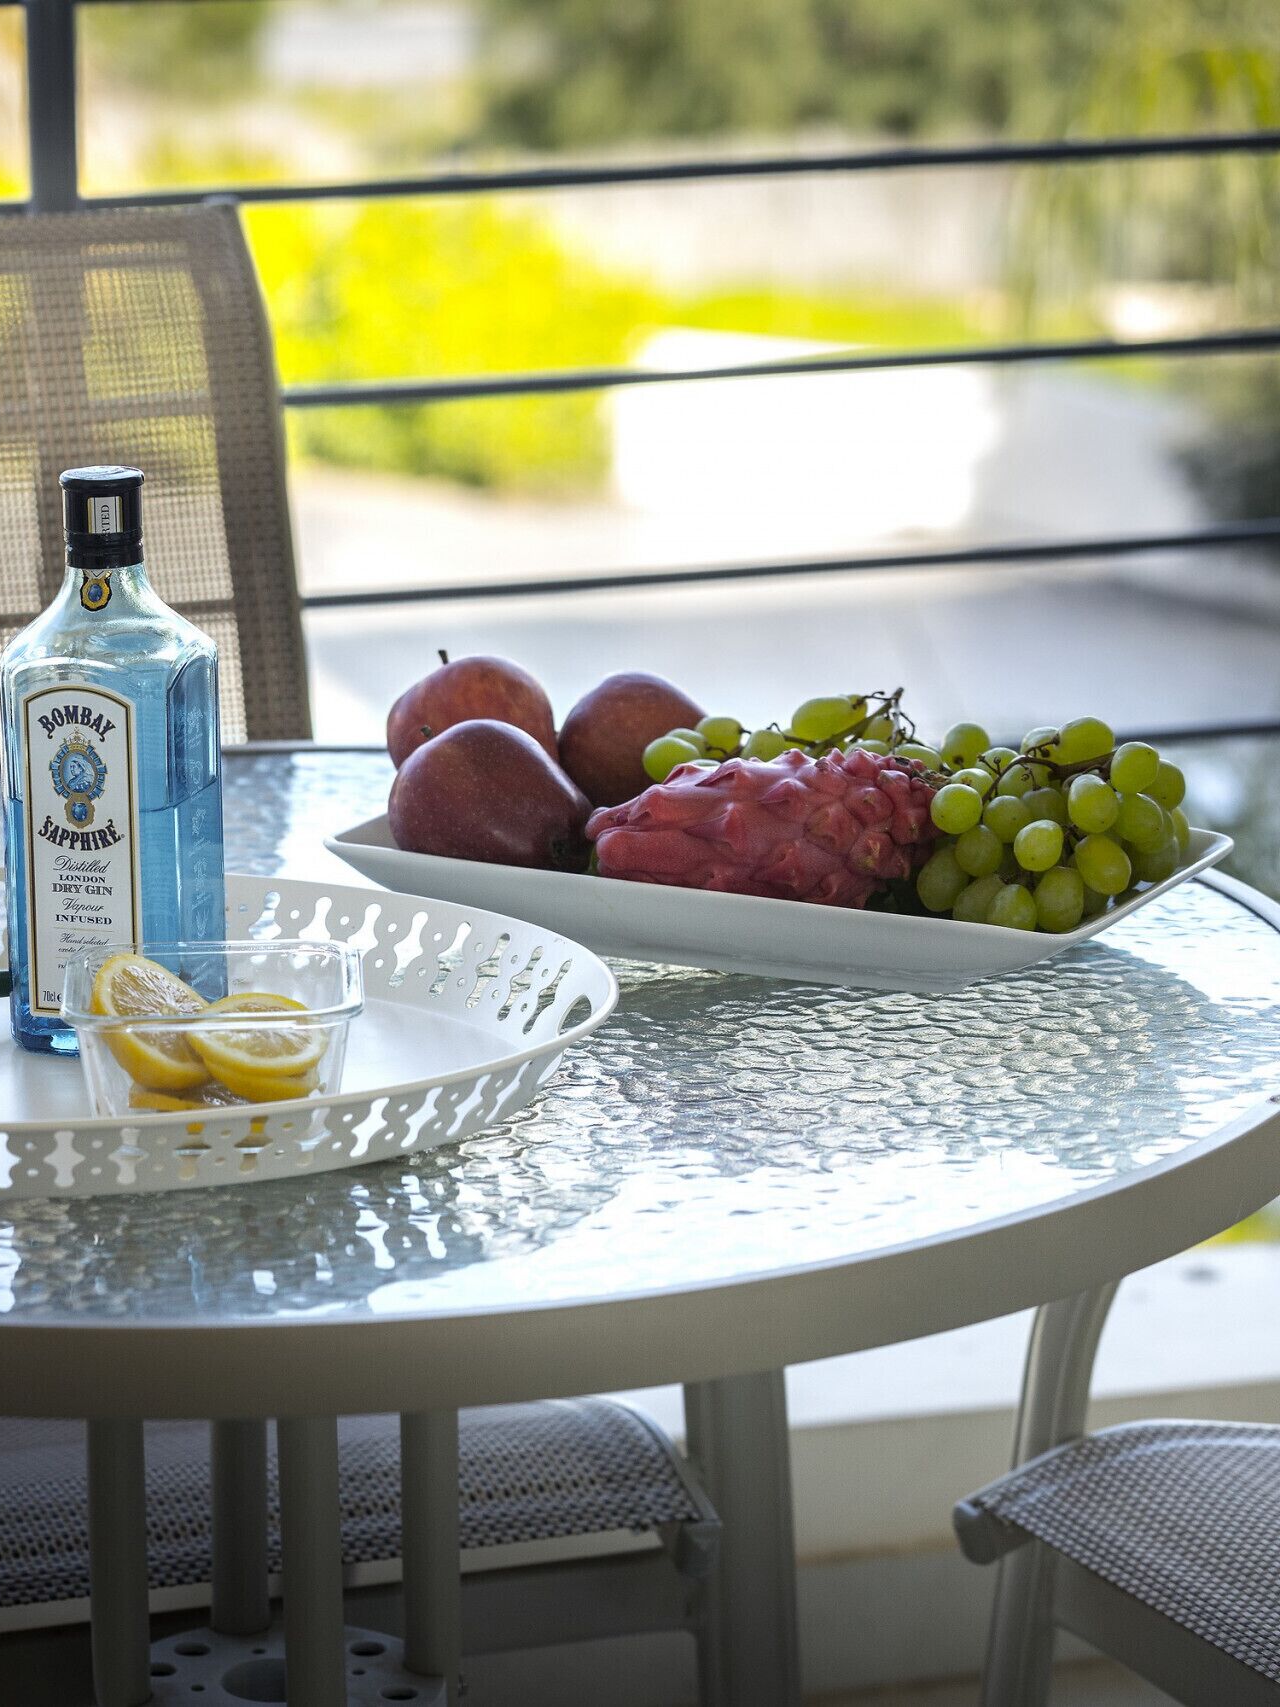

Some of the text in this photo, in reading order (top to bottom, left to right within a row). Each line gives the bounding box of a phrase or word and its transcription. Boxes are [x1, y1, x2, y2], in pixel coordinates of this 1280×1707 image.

[37, 705, 116, 742] BOMBAY
[37, 815, 121, 851] SAPPHIRE
[53, 855, 111, 874] Distilled
[59, 874, 106, 884] LONDON
[52, 882, 113, 896] DRY GIN
[61, 898, 104, 913] Vapour
[56, 914, 112, 925] INFUSED
[59, 932, 84, 944] Hand
